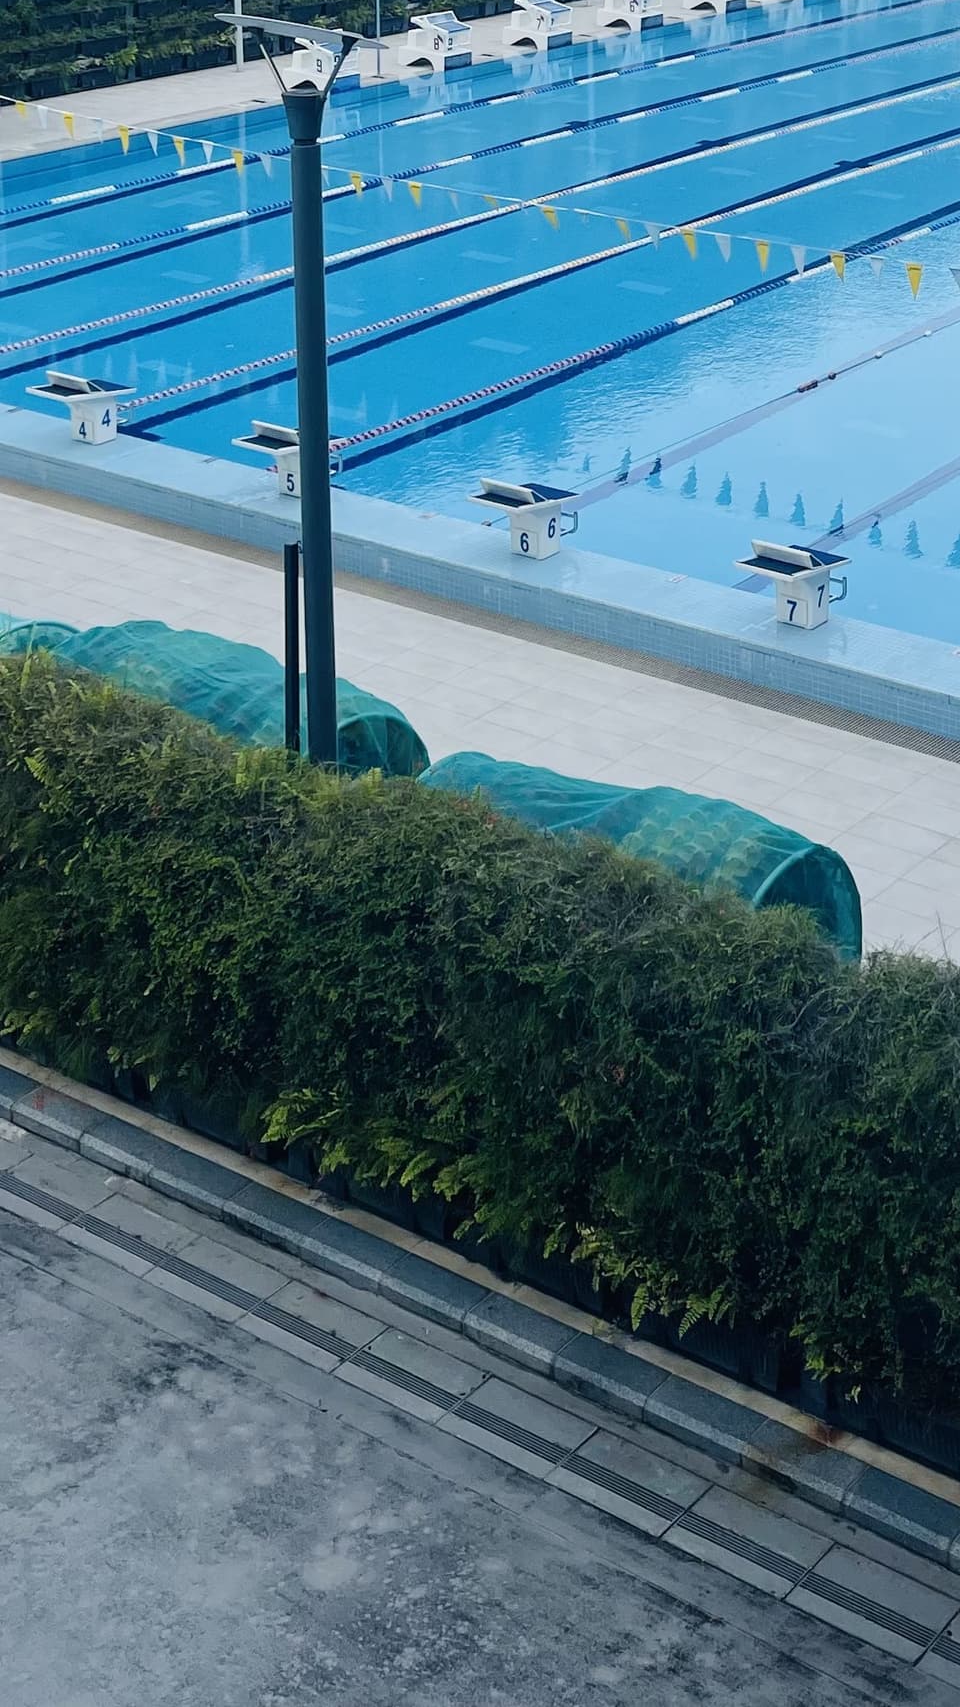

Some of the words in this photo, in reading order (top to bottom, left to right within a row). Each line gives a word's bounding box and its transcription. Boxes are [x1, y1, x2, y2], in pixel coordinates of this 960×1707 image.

[433, 37, 440, 50] 8
[316, 59, 323, 73] 9
[101, 408, 111, 427] 4
[78, 421, 87, 439] 4
[286, 473, 295, 492] 5
[547, 517, 556, 539] 6
[520, 532, 529, 553] 6
[817, 584, 825, 608] 7
[786, 599, 797, 622] 7
